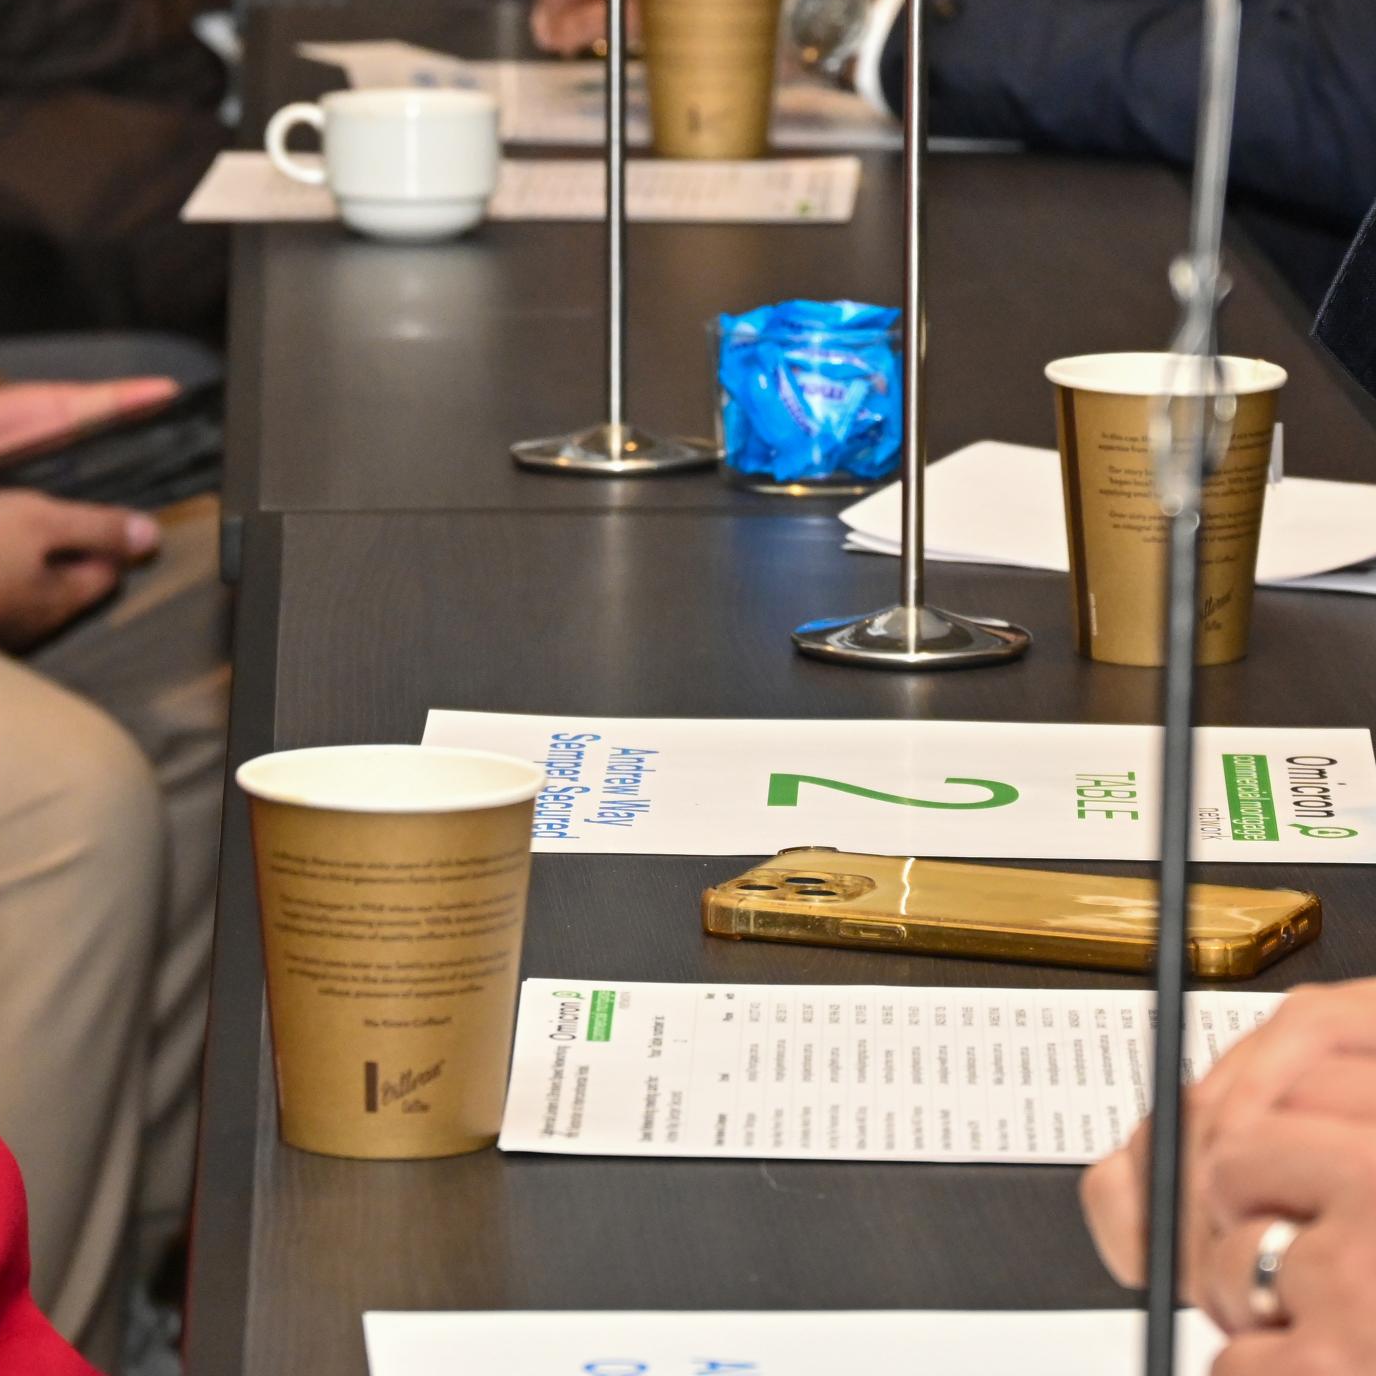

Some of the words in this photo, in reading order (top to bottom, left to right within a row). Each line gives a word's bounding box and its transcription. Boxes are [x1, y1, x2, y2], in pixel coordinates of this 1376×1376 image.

[534, 733, 602, 782] Semper
[602, 747, 660, 795] Andrew
[1233, 755, 1271, 801] commercial
[767, 773, 1020, 810] 2
[1076, 771, 1139, 820] TABLE
[1286, 756, 1347, 818] Omicron
[532, 786, 591, 839] Secured
[584, 799, 651, 827] Way
[1198, 808, 1231, 840] network
[1232, 801, 1272, 840] mortgage
[548, 1002, 580, 1041] Omicron
